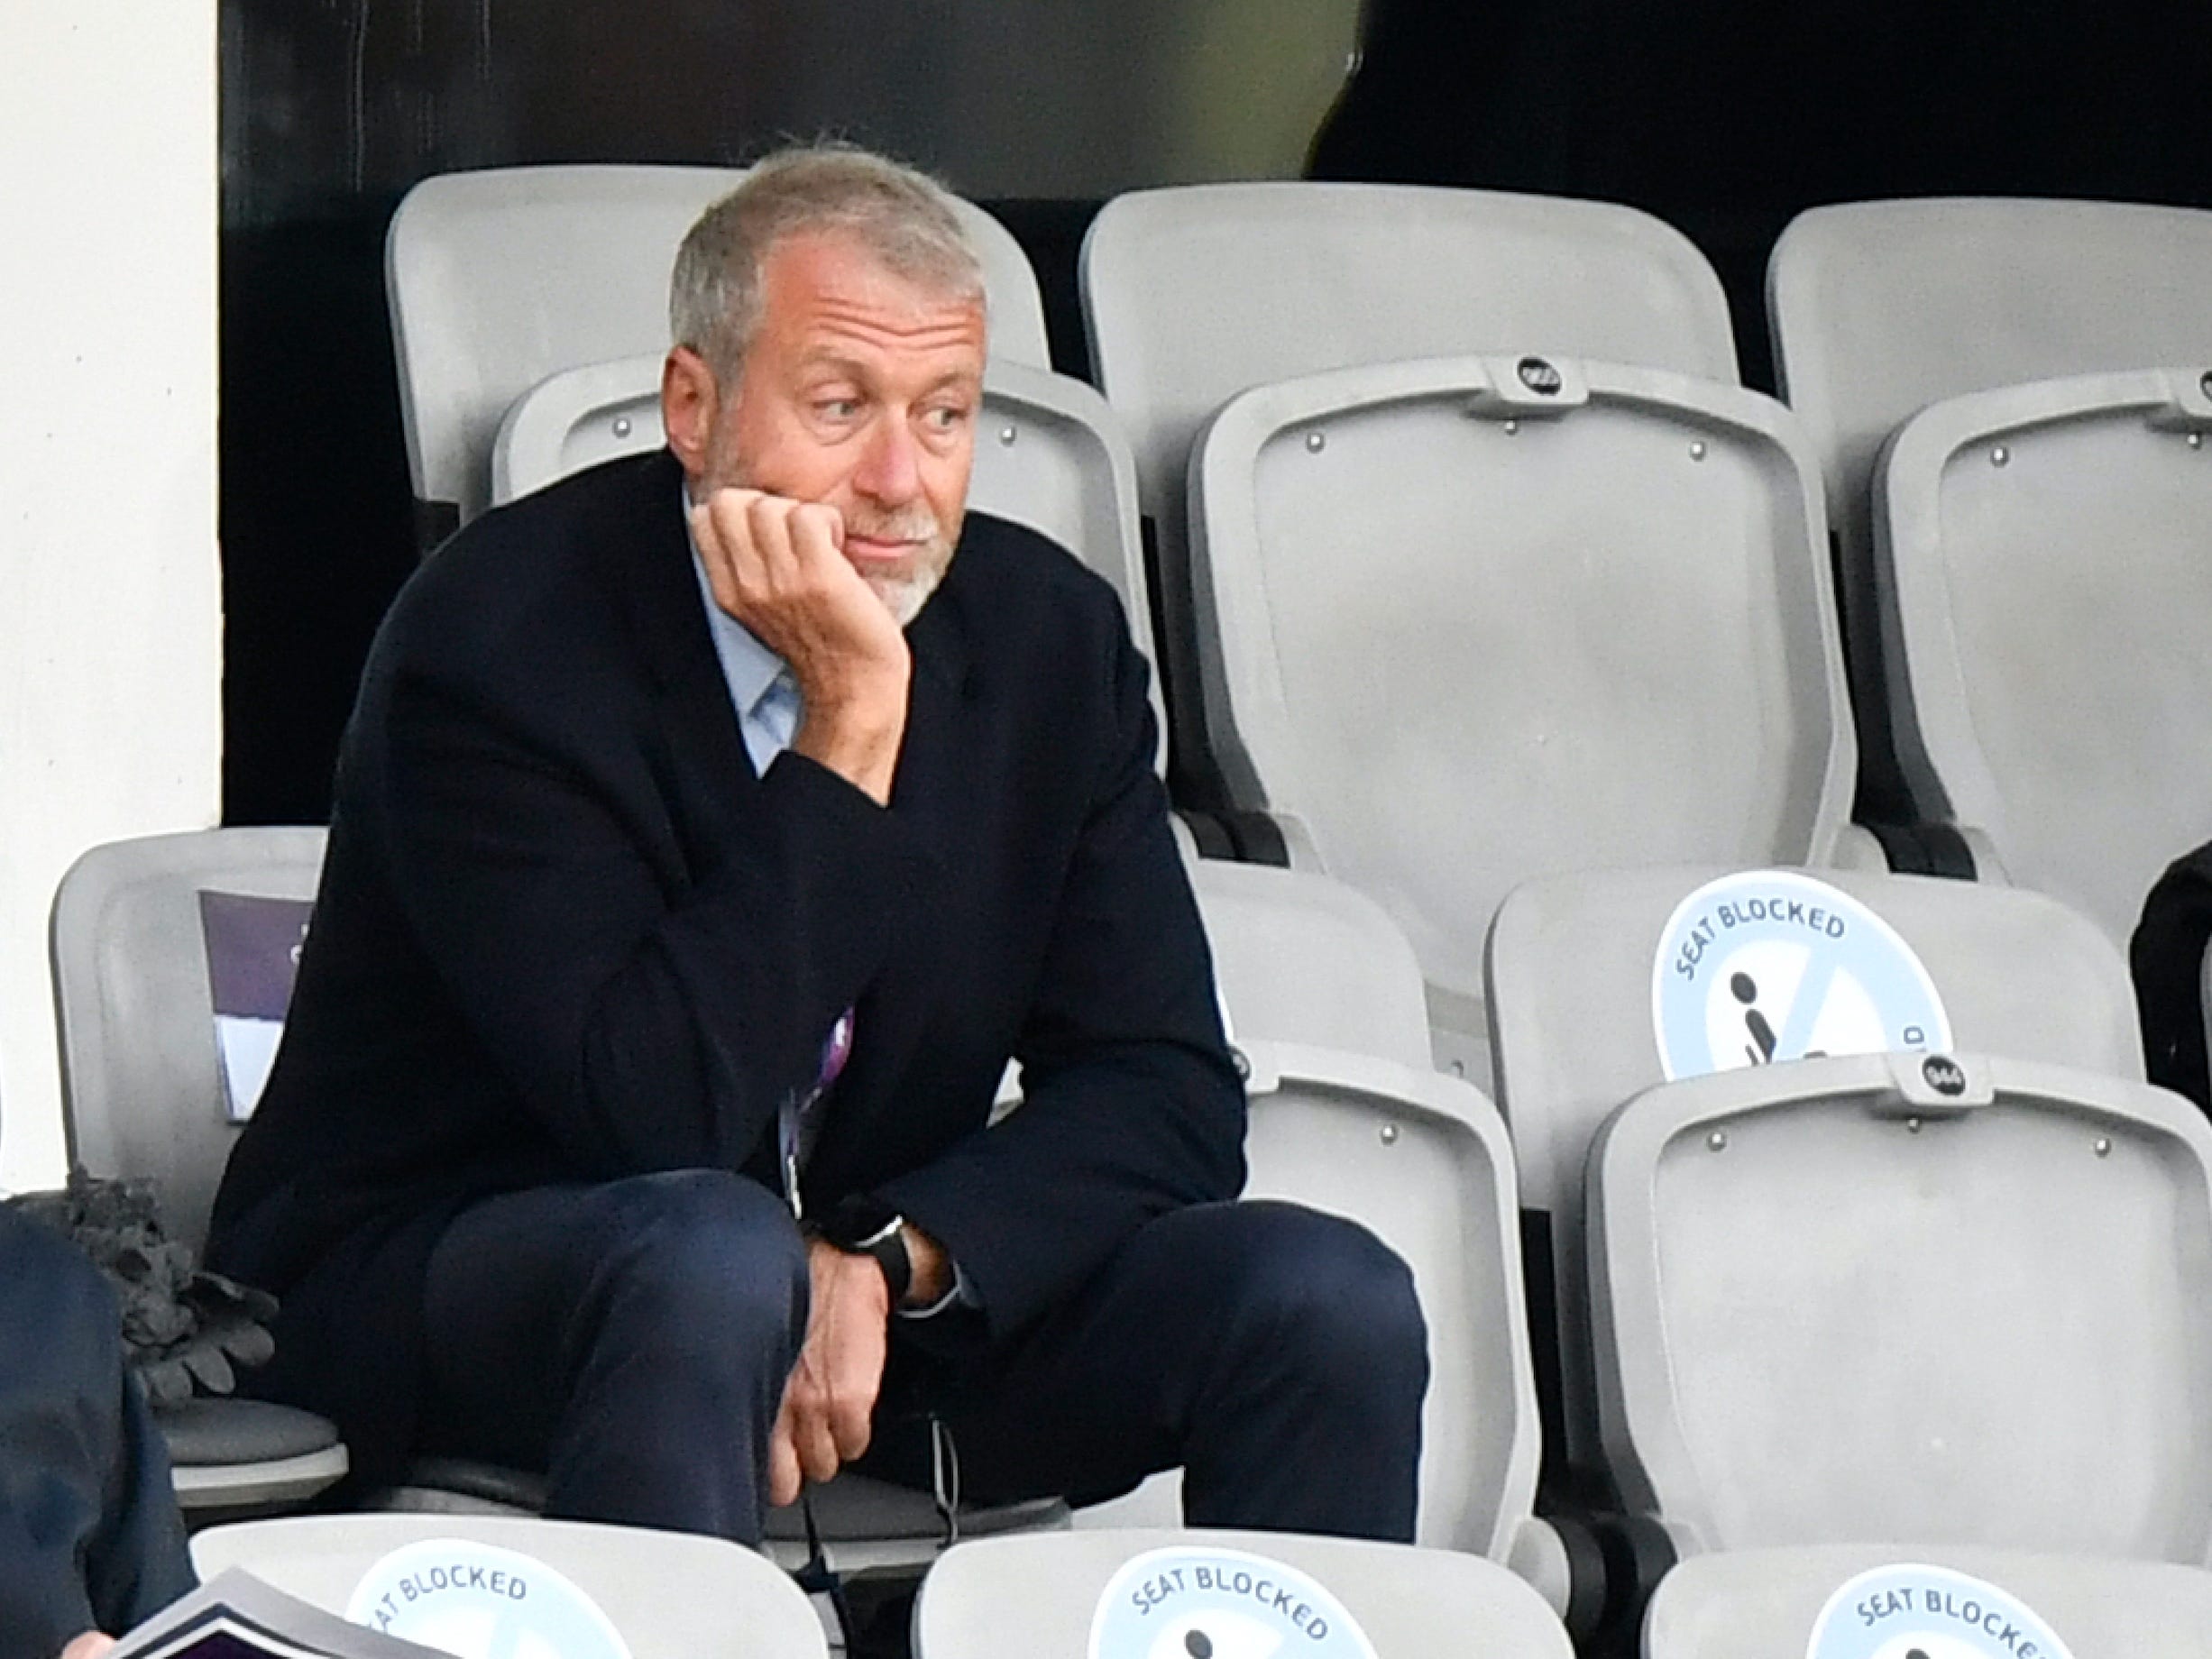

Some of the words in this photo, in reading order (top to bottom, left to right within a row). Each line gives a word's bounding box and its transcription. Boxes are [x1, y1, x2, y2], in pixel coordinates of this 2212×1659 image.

[1676, 916, 1715, 982] SEAT
[1718, 898, 1845, 939] BLOCKED
[368, 1592, 399, 1636] AT
[399, 1564, 527, 1601] BLOCKED
[1132, 1568, 1185, 1616] SEAT
[1196, 1566, 1328, 1640] BLOCKED
[1857, 1589, 1913, 1627] SEAT
[1925, 1589, 2046, 1659] BLOCKE
